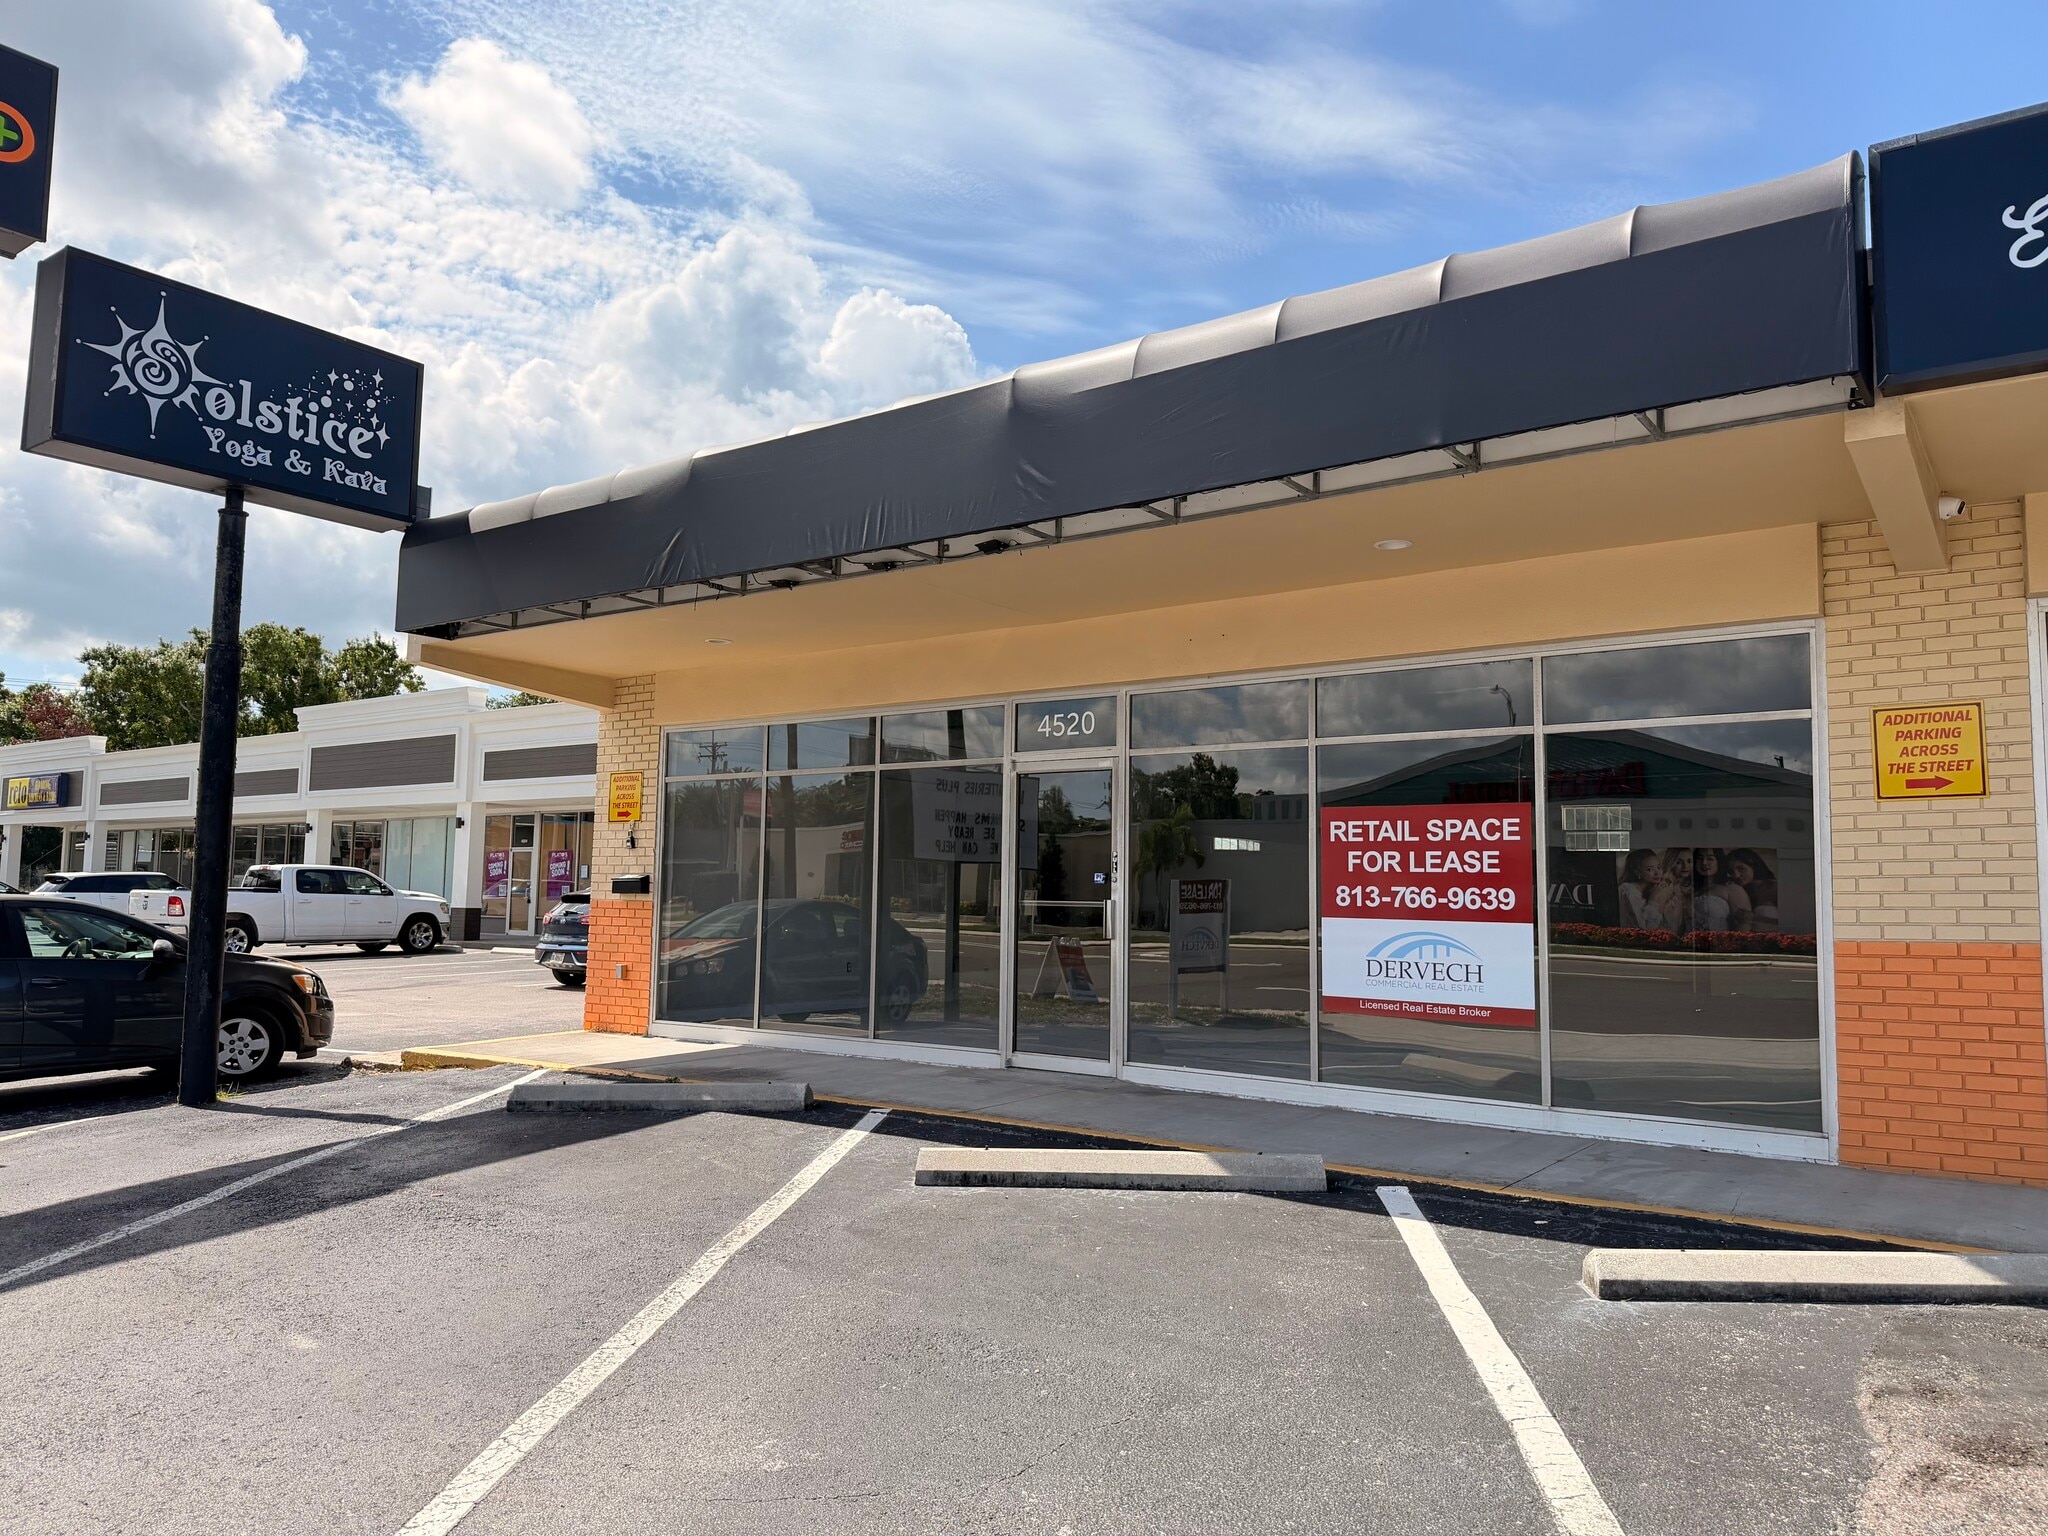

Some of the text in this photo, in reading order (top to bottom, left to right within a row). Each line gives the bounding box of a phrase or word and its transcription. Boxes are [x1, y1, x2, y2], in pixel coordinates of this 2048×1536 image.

[203, 425, 388, 496] Yoga & Kava
[1037, 710, 1096, 738] 4520
[1882, 709, 1973, 727] ADDITIONAL
[1895, 727, 1962, 742] PARKING
[1899, 743, 1959, 758] ACROSS
[1887, 759, 1975, 775] THE STREET
[612, 775, 640, 783] ADDITIONAL
[615, 784, 637, 792] PARKING
[621, 801, 639, 809] STREET
[1329, 817, 1521, 842] RETAIL SPACE
[1347, 850, 1501, 874] FOR LEASE
[1335, 885, 1516, 911] 813-766-9639
[1365, 958, 1484, 984] DERVECH
[1365, 978, 1485, 993] COMMERCIAL REAL ESTATE
[1359, 1000, 1492, 1018] Licensed Real Estate Broker
